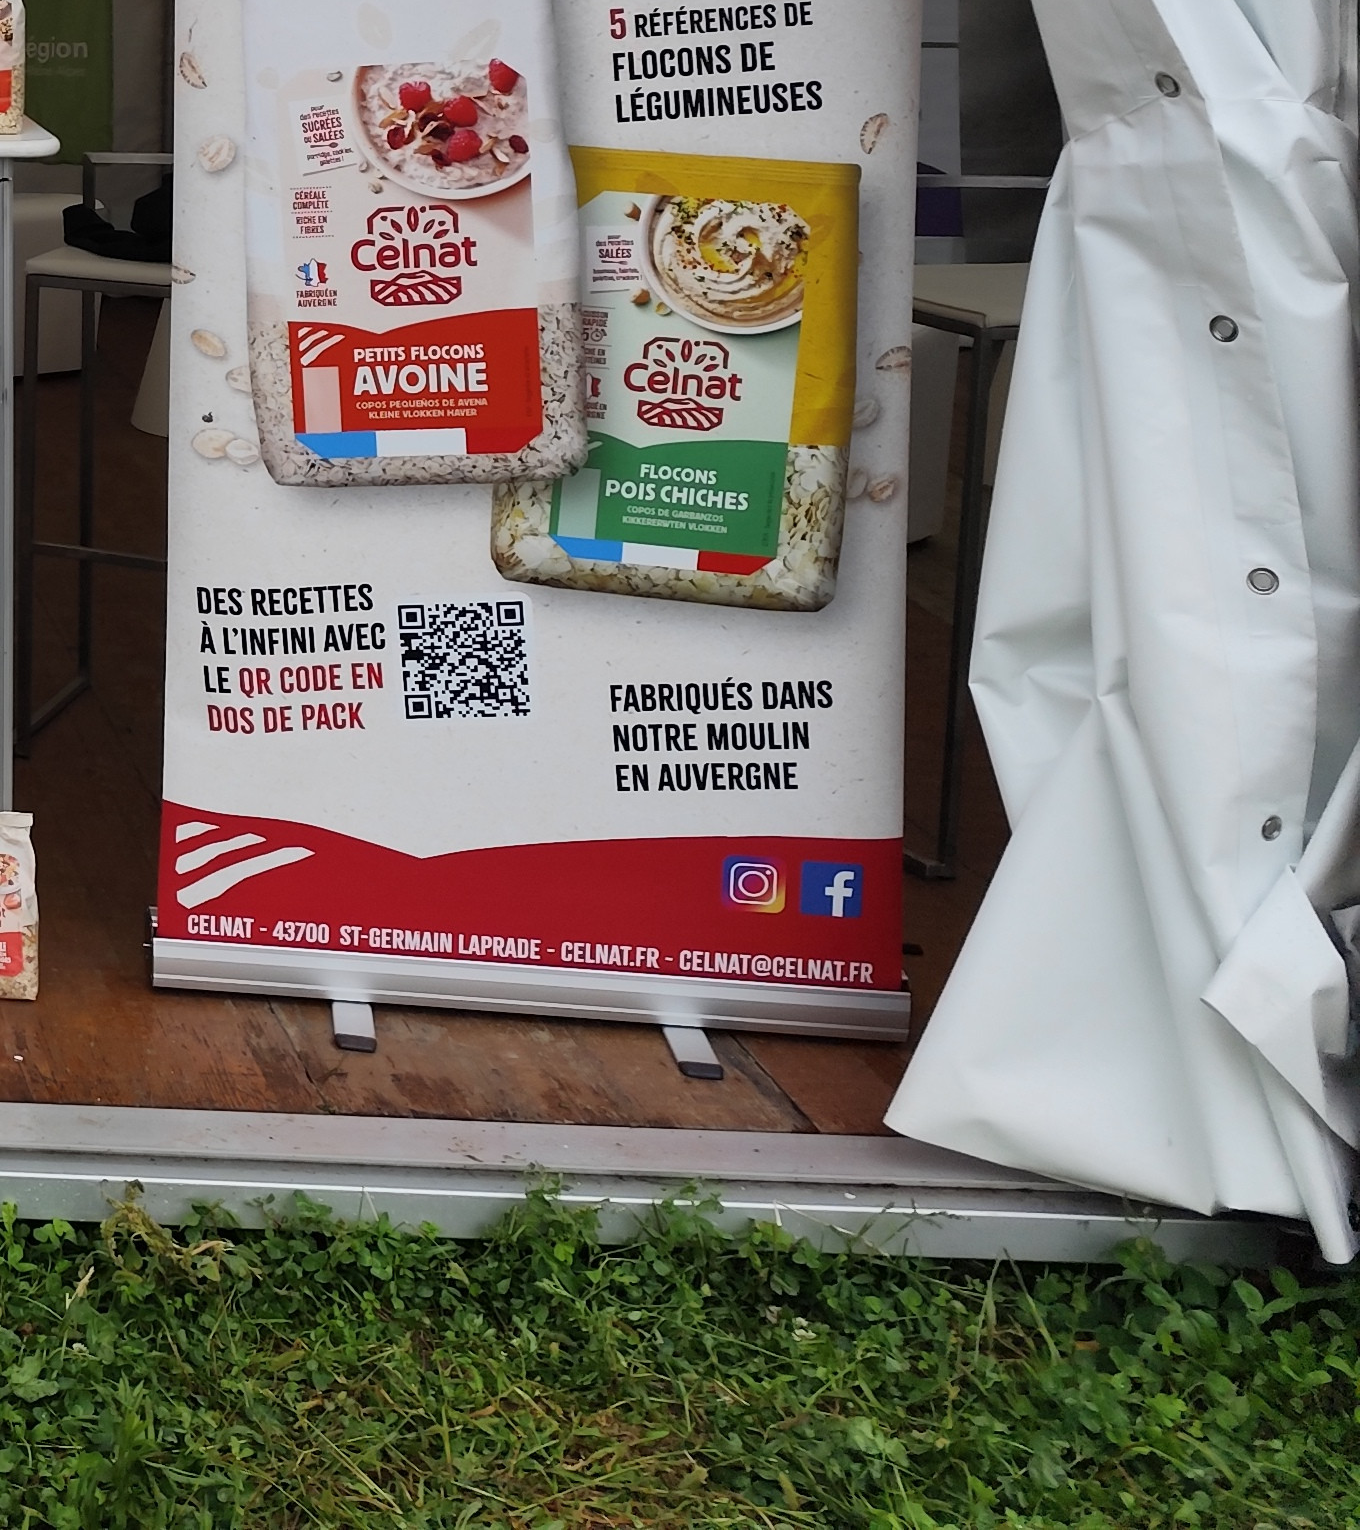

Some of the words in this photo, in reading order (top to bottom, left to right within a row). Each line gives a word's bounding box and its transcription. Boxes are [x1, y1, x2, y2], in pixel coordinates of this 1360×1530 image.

[608, 7, 628, 40] 5
[633, 3, 777, 39] RÉFÉRENCES
[783, 0, 814, 27] DE
[612, 45, 732, 82] FLOCONS
[739, 41, 776, 72] DE
[614, 80, 824, 124] LÉGUMINEUSES
[302, 116, 342, 133] SUCRÉES
[313, 129, 345, 143] SALÉES
[292, 199, 330, 210] COMPLÈTE
[294, 190, 327, 200] CÉRÉALE
[350, 237, 478, 271] Celnat
[598, 247, 632, 259] SALÉES
[297, 298, 338, 307] AUVERGNE
[353, 347, 406, 363] PETITS
[411, 344, 485, 361] FLOCONS
[353, 362, 489, 396] AVOINE
[624, 363, 743, 401] Celnat
[356, 400, 387, 410] COPOS
[389, 397, 440, 409] PEQUEÑOS
[443, 398, 456, 408] DE
[457, 397, 488, 407] AVENA
[368, 410, 398, 420] KLEINE
[401, 409, 448, 419] VLOKKEN
[449, 408, 478, 418] HAVER
[640, 464, 717, 485] FLOCONS
[604, 478, 656, 501] POIS
[660, 486, 749, 511] CHICHES
[627, 505, 655, 516] COPOS
[657, 507, 671, 517] DE
[196, 586, 245, 617] DES
[250, 583, 374, 616] RECETTES
[199, 622, 216, 656] À
[222, 627, 316, 658] L'INFINI
[323, 621, 386, 652] AVEC
[204, 667, 232, 695] LE
[238, 666, 273, 696] QR
[280, 664, 343, 694] CODE
[350, 662, 384, 691] EN
[609, 676, 753, 713] FABRIQUÉS
[761, 679, 834, 710] DANS
[207, 703, 255, 734] DOS
[263, 703, 293, 733] DE
[299, 701, 365, 732] PACK
[612, 722, 698, 752] NOTRE
[706, 719, 811, 751] MOULIN
[615, 765, 650, 792] EN
[657, 762, 799, 791] AUVERGNE
[187, 914, 255, 939] CELNAT
[272, 920, 330, 944] 43700
[339, 925, 453, 953] ST-GERMAIN
[458, 934, 542, 961] LAPRADE
[560, 941, 660, 969] CELNAT.FR
[679, 949, 874, 984] CELNAT@CELNAT.FR
